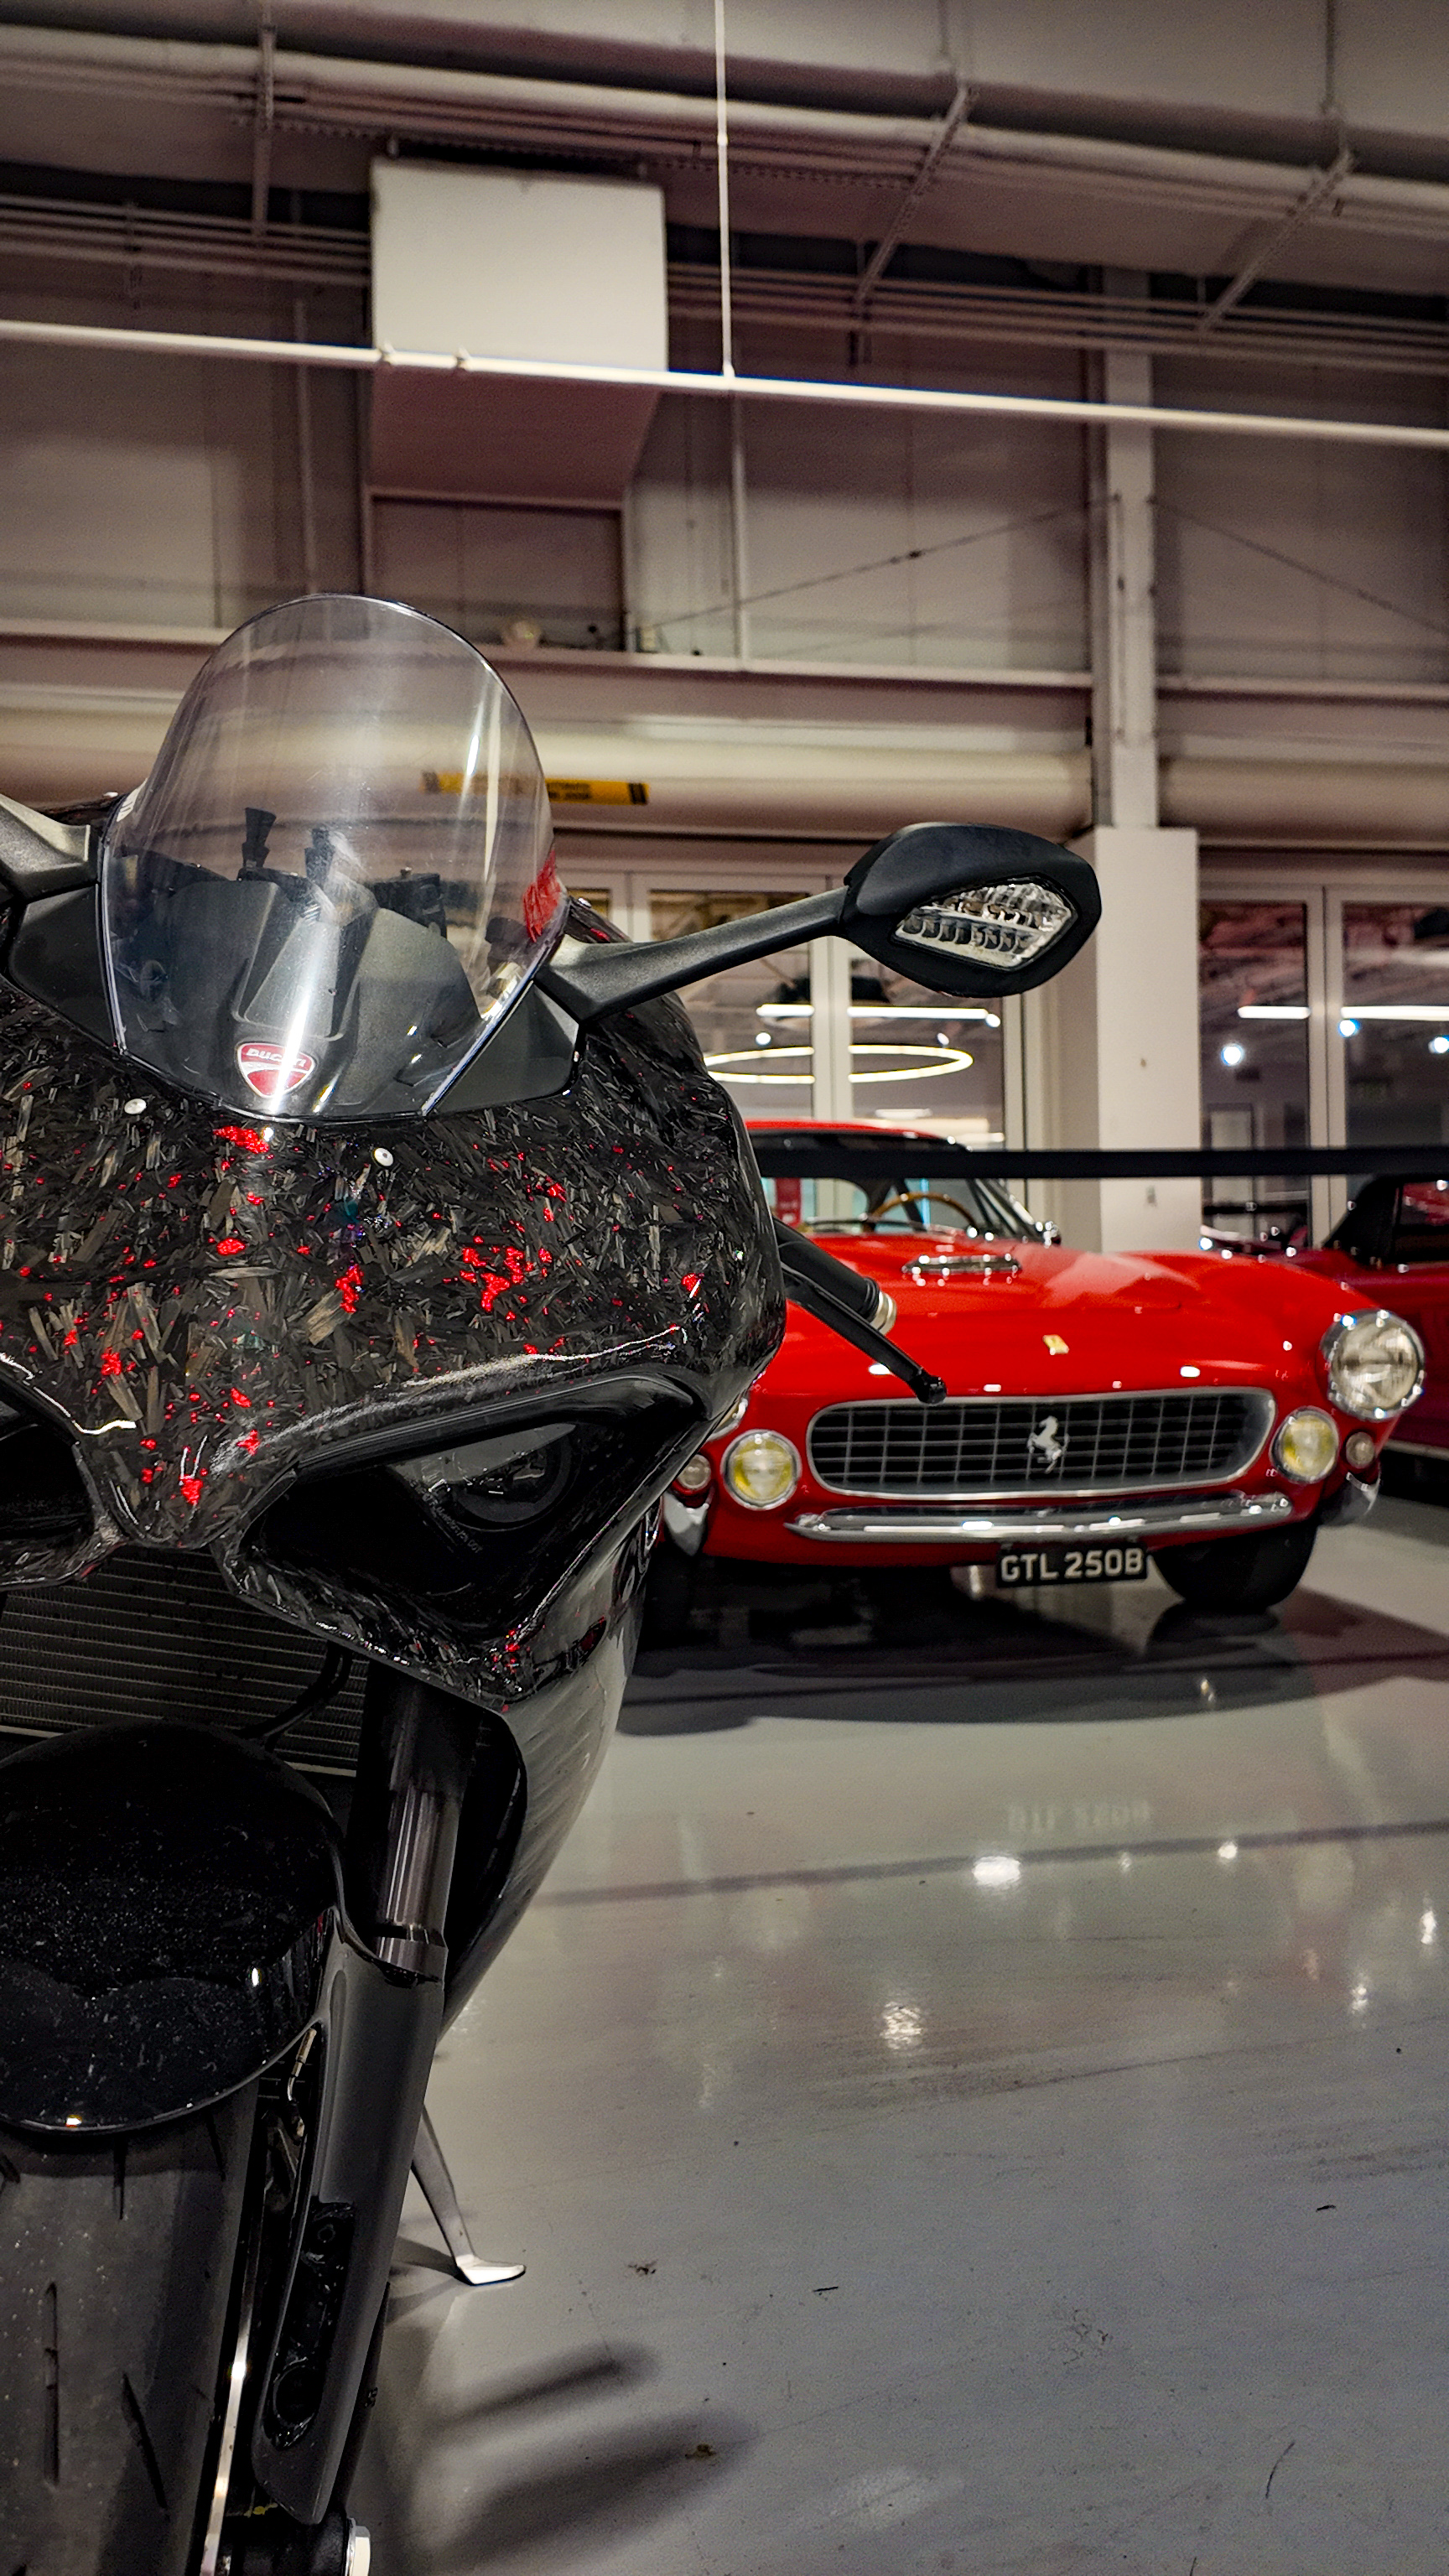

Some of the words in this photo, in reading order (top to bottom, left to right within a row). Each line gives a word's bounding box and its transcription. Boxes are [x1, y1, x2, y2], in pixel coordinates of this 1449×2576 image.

[246, 1047, 307, 1067] DUCI
[1000, 1553, 1059, 1581] GTL
[1064, 1548, 1143, 1578] 250B
